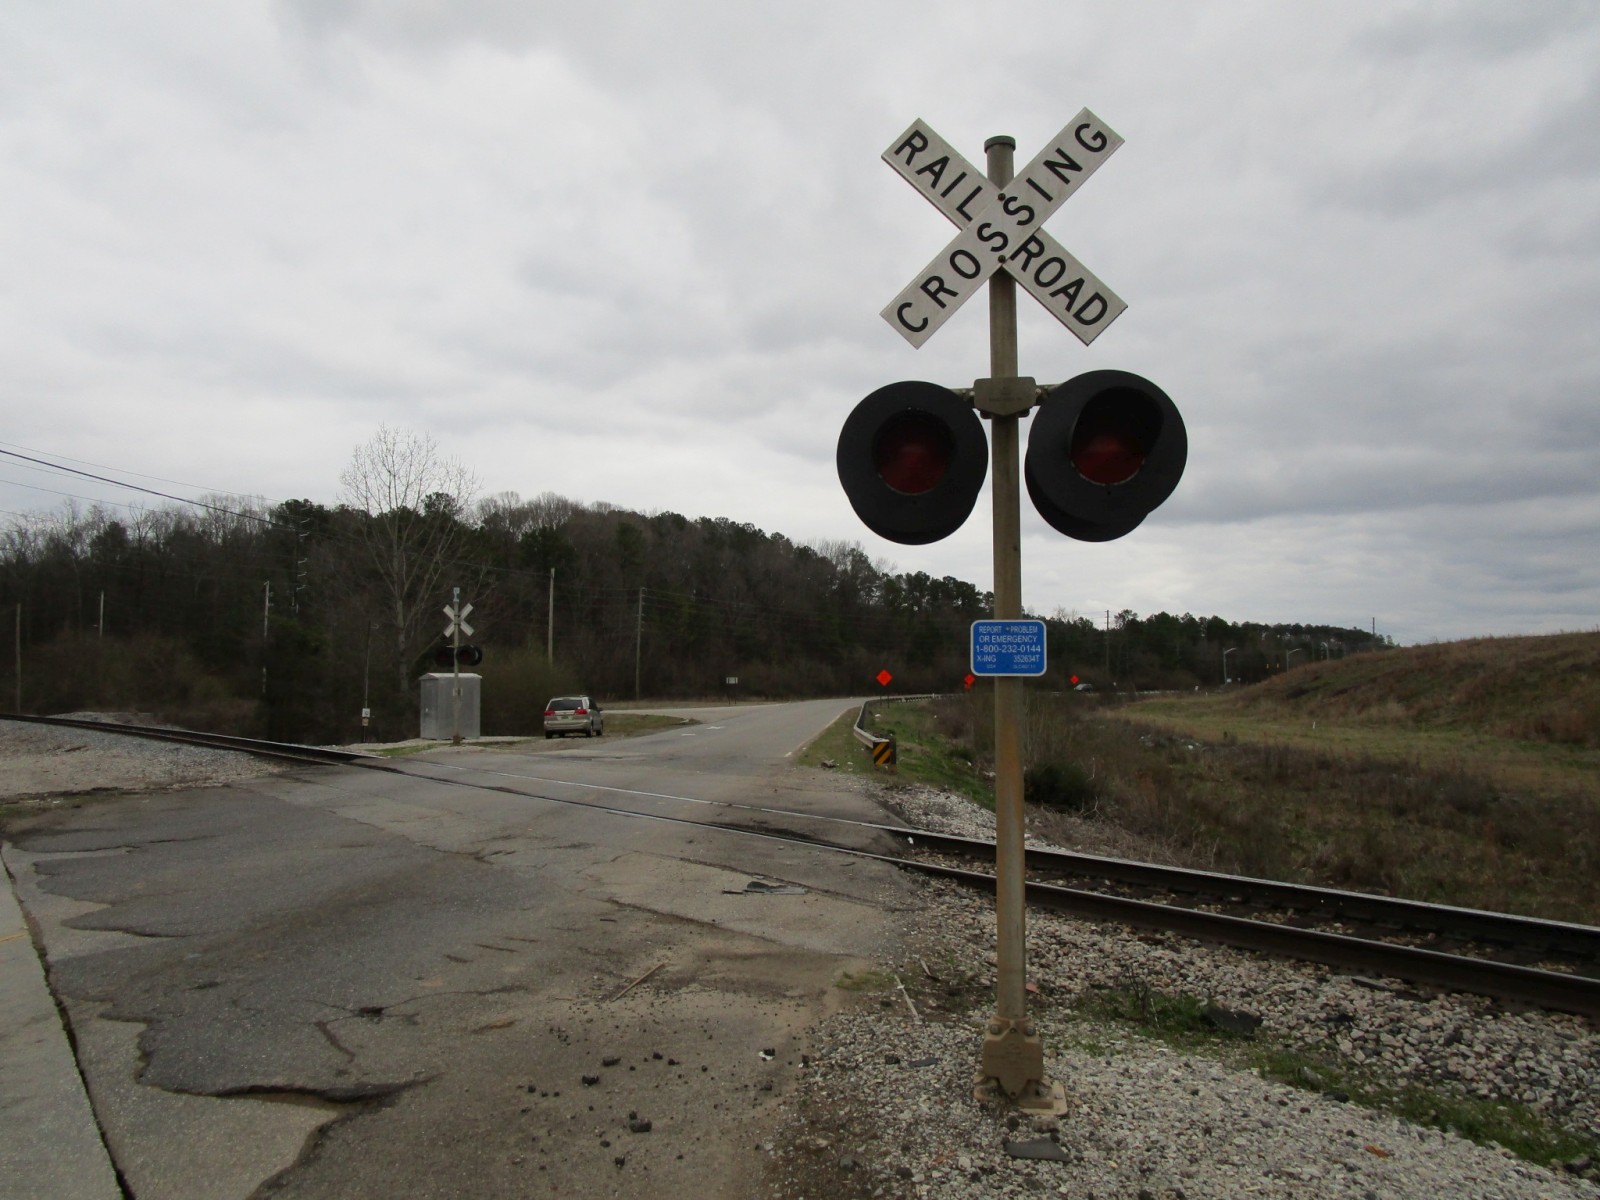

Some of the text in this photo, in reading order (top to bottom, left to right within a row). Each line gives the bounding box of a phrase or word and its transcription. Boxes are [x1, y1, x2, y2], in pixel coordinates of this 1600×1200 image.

[894, 129, 1108, 326] RAIL ROAD
[897, 122, 1108, 333] CROSSING
[978, 625, 1038, 633] REPORT PROBLEM
[978, 635, 1038, 643] OR EMERGENCY
[976, 645, 1041, 653] 1-800-232-0144
